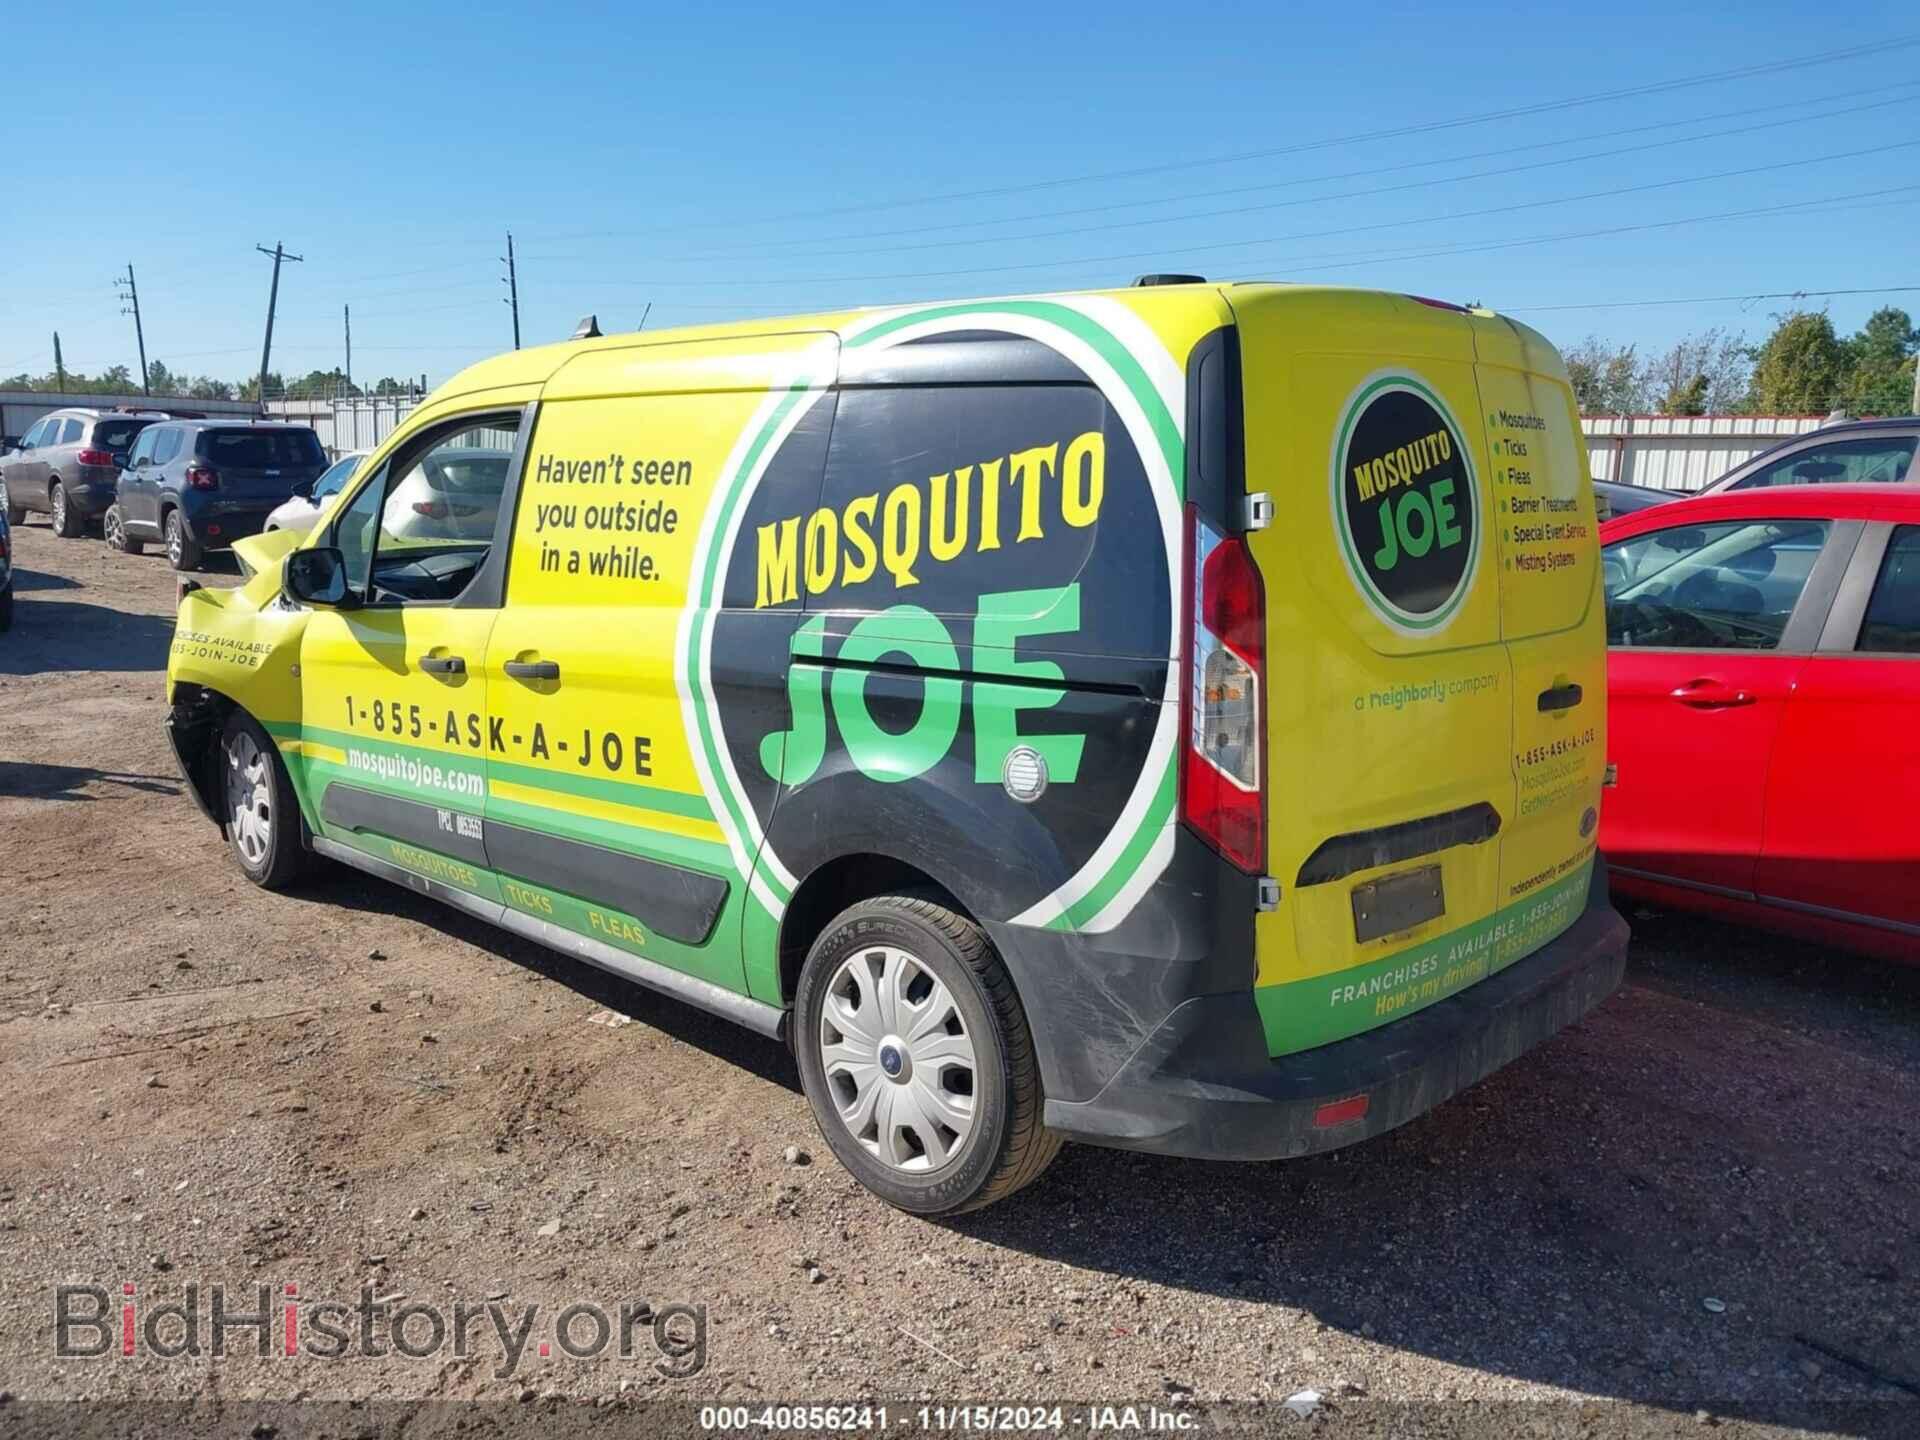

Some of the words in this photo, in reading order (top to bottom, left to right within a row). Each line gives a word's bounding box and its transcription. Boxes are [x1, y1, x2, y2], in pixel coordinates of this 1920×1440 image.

[1354, 430, 1451, 502] MOSQUITO
[1504, 438, 1527, 457] Ticks
[537, 453, 625, 484] Haven't
[631, 460, 692, 486] seen
[1508, 467, 1531, 486] Fleas
[536, 503, 577, 533] you
[584, 499, 678, 534] outside
[755, 431, 1106, 609] MOSQUITO
[1375, 478, 1462, 570] JOE
[1511, 496, 1540, 514] Barrier
[1514, 526, 1544, 545] Special
[541, 541, 560, 572] in
[567, 550, 580, 574] a
[589, 545, 659, 581] while.
[1515, 552, 1546, 572] Misting
[1548, 551, 1576, 571] Systems
[211, 636, 272, 654] AVAILABLE
[759, 582, 1087, 786] JOE
[1354, 697, 1364, 711] a
[1369, 680, 1446, 710] neighborly
[1448, 671, 1499, 695] company
[346, 695, 653, 776] 1-855-ASK-A-JOE
[1515, 727, 1596, 769] 1-855-ASK-A-JOE
[349, 748, 484, 797] mosquitojoe.com
[391, 843, 478, 888] MOSQUITOES
[506, 886, 553, 914] TICKS
[588, 911, 647, 946] FLEAS
[1331, 954, 1439, 1008] FRANCHISES
[1448, 918, 1516, 962] AVAILABLE
[1375, 985, 1418, 1016] How's
[1420, 975, 1441, 999] my
